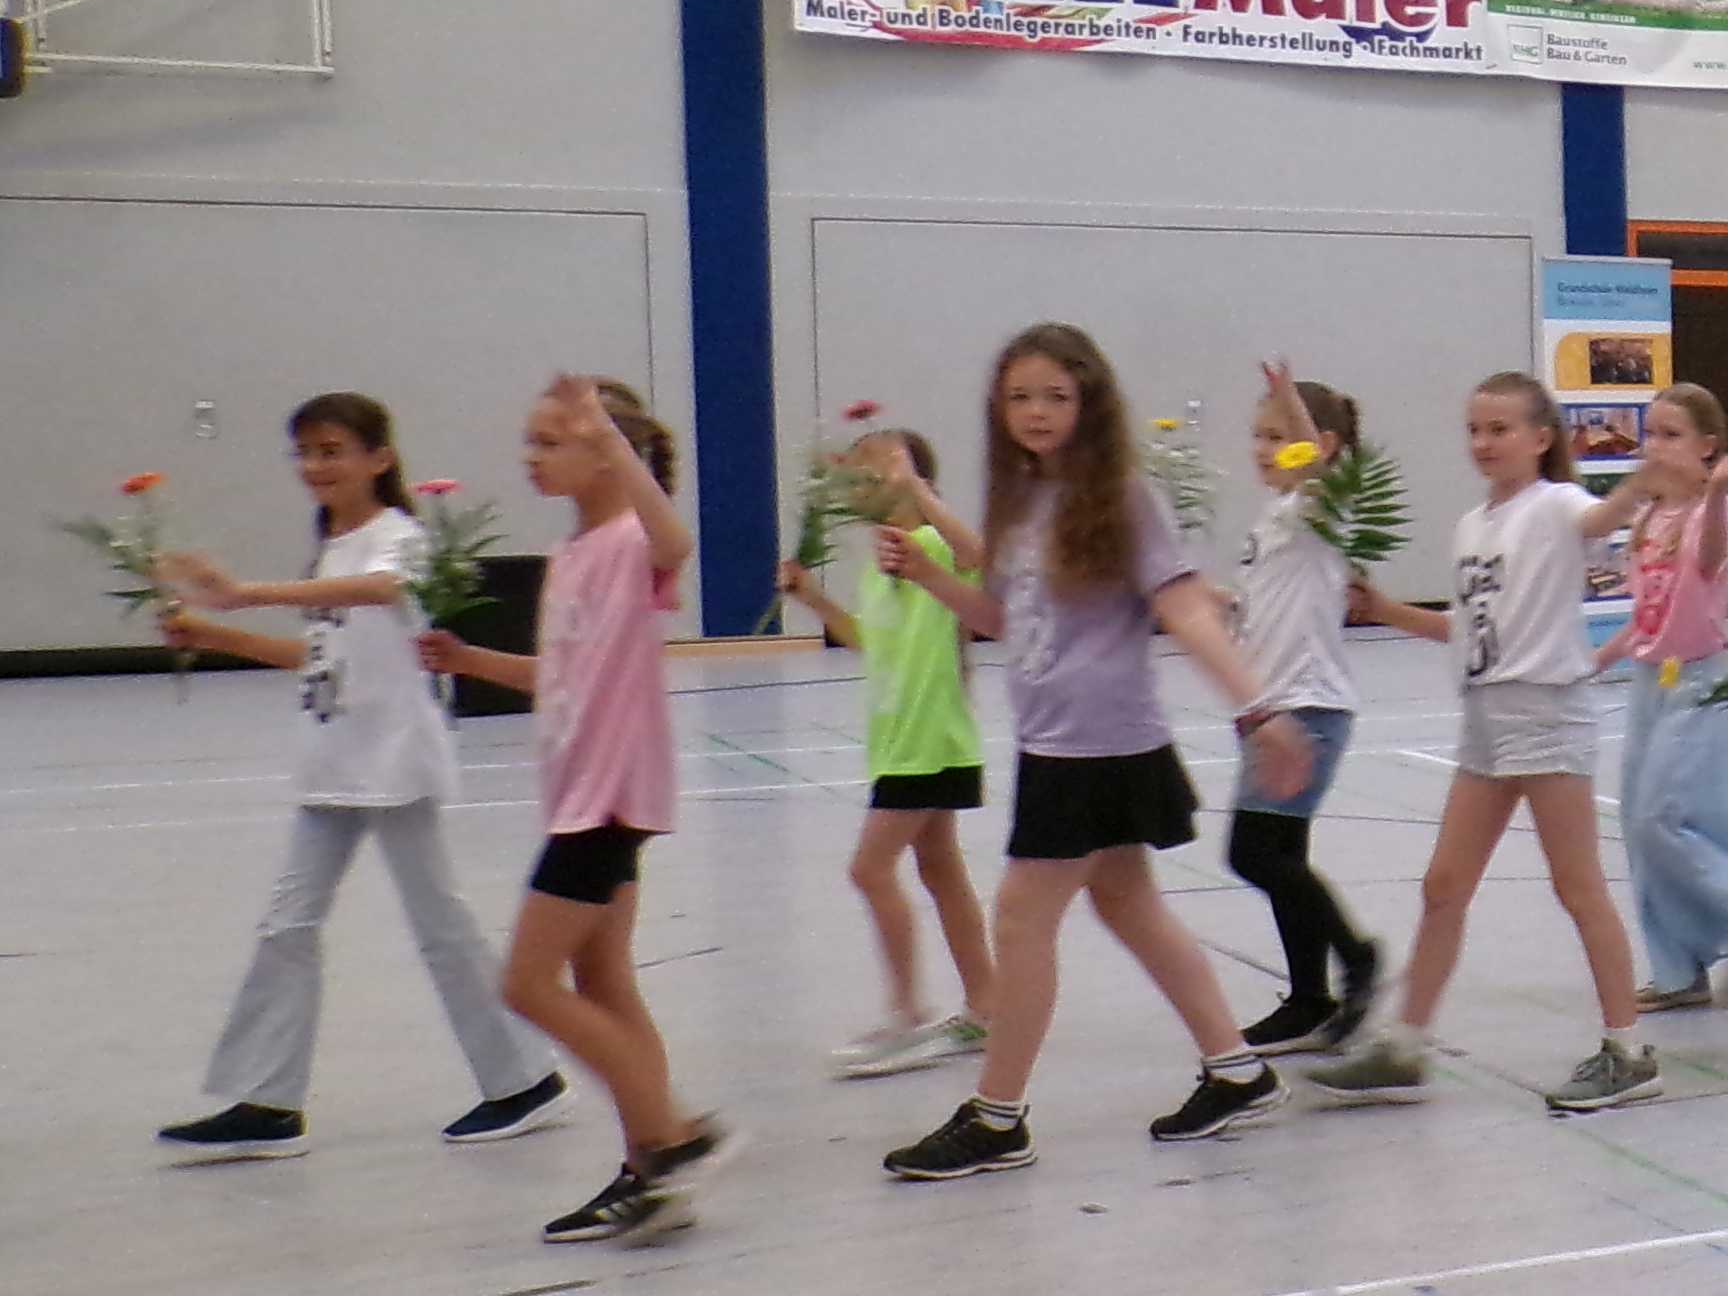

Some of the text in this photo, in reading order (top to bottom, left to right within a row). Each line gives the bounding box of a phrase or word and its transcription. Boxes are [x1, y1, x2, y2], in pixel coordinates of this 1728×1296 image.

[886, 4, 929, 27] und
[938, 7, 1157, 41] Bodenlegerarbeiten
[1181, 27, 1352, 58] Farbherstellung
[1378, 37, 1483, 61] Fachmarkt
